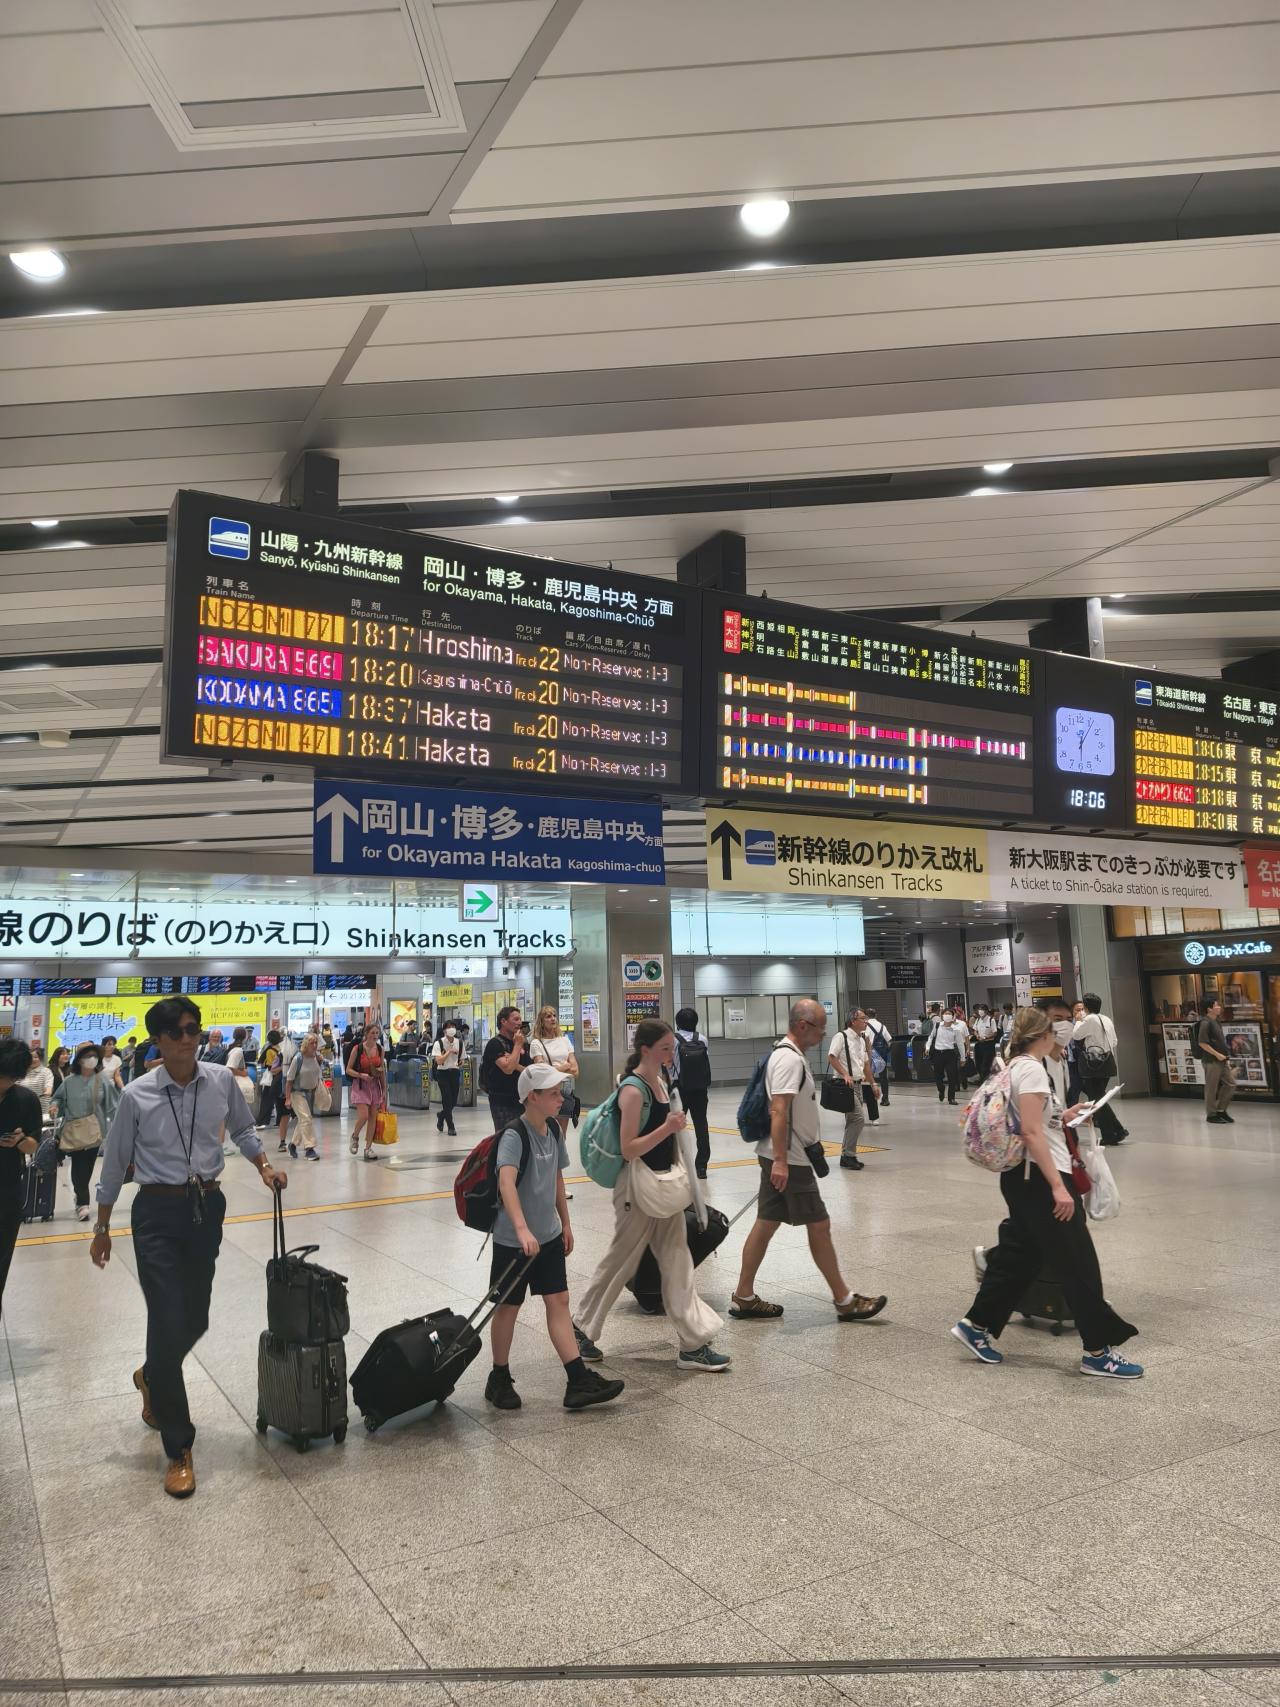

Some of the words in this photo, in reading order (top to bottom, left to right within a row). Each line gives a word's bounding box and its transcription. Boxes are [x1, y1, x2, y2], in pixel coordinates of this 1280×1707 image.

[260, 530, 403, 570] 山陽・九州新幹線
[260, 551, 297, 569] Sanyō,
[301, 559, 339, 575] Kyūshū
[342, 565, 400, 585] Shinkansen
[206, 586, 229, 597] Train
[231, 590, 255, 600] Name
[423, 555, 638, 611] 岡山・博多・鹿児島中央
[644, 597, 673, 616] 方面
[351, 609, 389, 621] Departure
[391, 613, 409, 623] Time
[423, 579, 440, 592] for
[444, 582, 507, 605] Okayama,
[511, 594, 556, 613] Hakata,
[560, 602, 655, 628] Kagoshima-Chūō
[421, 619, 462, 631] Destination
[515, 633, 533, 641] Track
[725, 615, 734, 649] 新大阪
[741, 618, 750, 651] 新神戸
[756, 620, 765, 654] 西明石
[766, 622, 775, 656] 姫路
[776, 624, 785, 657] 相生
[306, 613, 331, 642] 77
[351, 620, 414, 652] 18:17
[539, 647, 559, 672] 22
[787, 625, 796, 659] 岡山
[801, 628, 810, 661] 新倉敷
[811, 630, 820, 662] 福山
[821, 632, 829, 664] 新尾道
[830, 633, 839, 665] 三原
[840, 635, 848, 667] 東広島
[850, 637, 858, 668] 広島
[863, 639, 871, 670] 新岩国
[872, 640, 881, 672] 徳山
[882, 642, 890, 673] 新山口
[891, 644, 899, 675] 厚狭
[900, 645, 908, 677] 新下関
[909, 647, 916, 678] 小倉
[921, 649, 929, 679] 博多
[942, 653, 950, 682] 久留米
[959, 655, 967, 685] 新大牟田
[976, 658, 983, 688] 熊本
[350, 657, 413, 688] 18:20
[538, 680, 559, 706] 20
[1004, 663, 1011, 692] 出水
[1011, 664, 1019, 694] 川内
[1155, 685, 1207, 704] 東海道新幹線
[1177, 702, 1205, 713] Shinkansen
[1223, 695, 1277, 716] 名古屋・東京
[349, 694, 412, 724] 18:37
[416, 702, 491, 732] Hakata
[537, 715, 558, 739] 20
[1223, 710, 1231, 719] for
[1232, 712, 1256, 724] Nagoya,
[302, 723, 327, 754] 47
[348, 731, 408, 760] 18:41
[415, 736, 490, 767] Hakata
[536, 748, 557, 774] 21
[1195, 763, 1224, 783] 18:15
[1071, 789, 1106, 809] 18:06
[1196, 787, 1224, 806] 18:18
[361, 798, 645, 843] 岡山・博多・鹿児島中央
[645, 835, 663, 848] 方面
[362, 846, 382, 859] for
[387, 844, 485, 867] Okayama
[491, 850, 561, 869] Hakata
[568, 858, 662, 874] Kagoshima-chuo
[777, 834, 984, 874] 新幹線のりかえ改札
[1009, 846, 1238, 881] 新大阪駅までのきっぷが必要です
[789, 868, 884, 889] Shinkansen
[891, 872, 944, 892] Tracks
[1010, 878, 1018, 890] A
[1020, 877, 1048, 892] ticket
[1051, 880, 1061, 892] to
[1065, 877, 1123, 895] Shin-Ōsaka
[1126, 882, 1157, 896] station
[1160, 884, 1168, 896] is
[1170, 883, 1213, 899] required.
[347, 926, 486, 948] Shinkansen
[494, 928, 567, 949] Tracks
[1207, 941, 1272, 959] Drip-X-Cafe
[63, 1011, 127, 1032] 佐賀県
[974, 1339, 987, 1350] N
[1103, 1361, 1119, 1373] N
